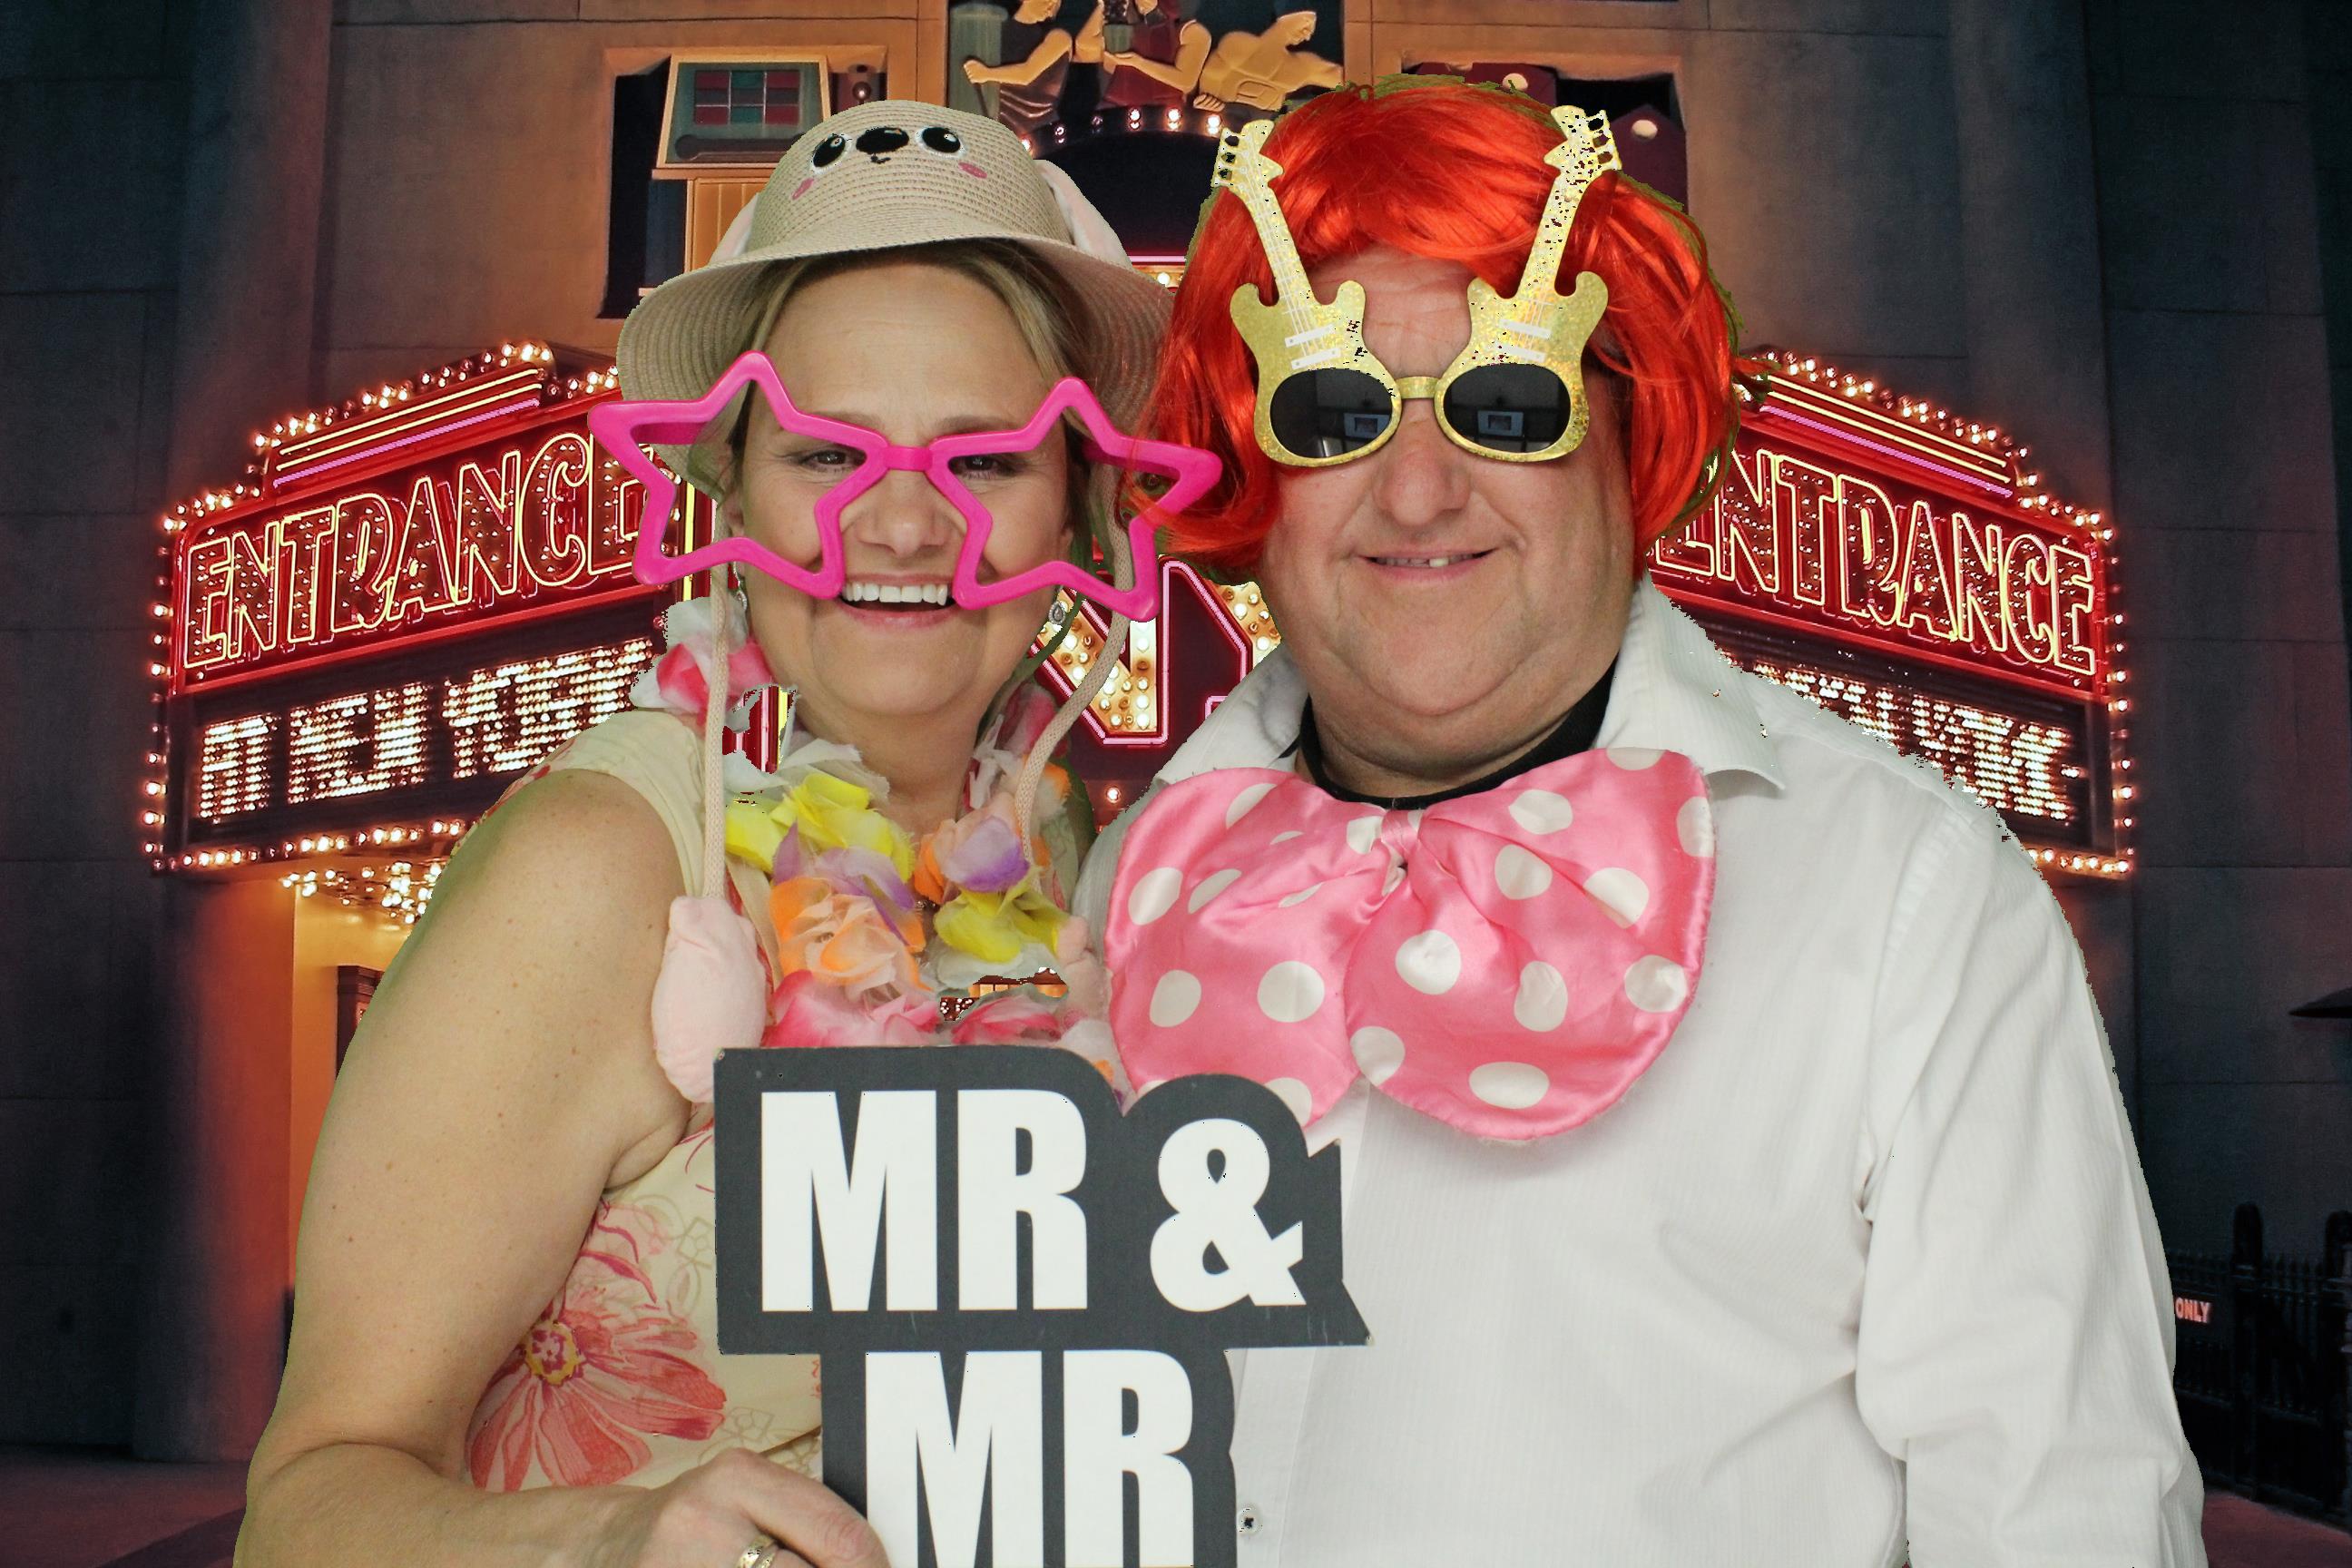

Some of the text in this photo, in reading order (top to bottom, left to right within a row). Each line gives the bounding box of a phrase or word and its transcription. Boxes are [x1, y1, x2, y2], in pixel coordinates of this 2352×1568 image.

[761, 1090, 1307, 1312] MR &
[2175, 1297, 2211, 1324] ONLY
[865, 1349, 1194, 1568] MR
